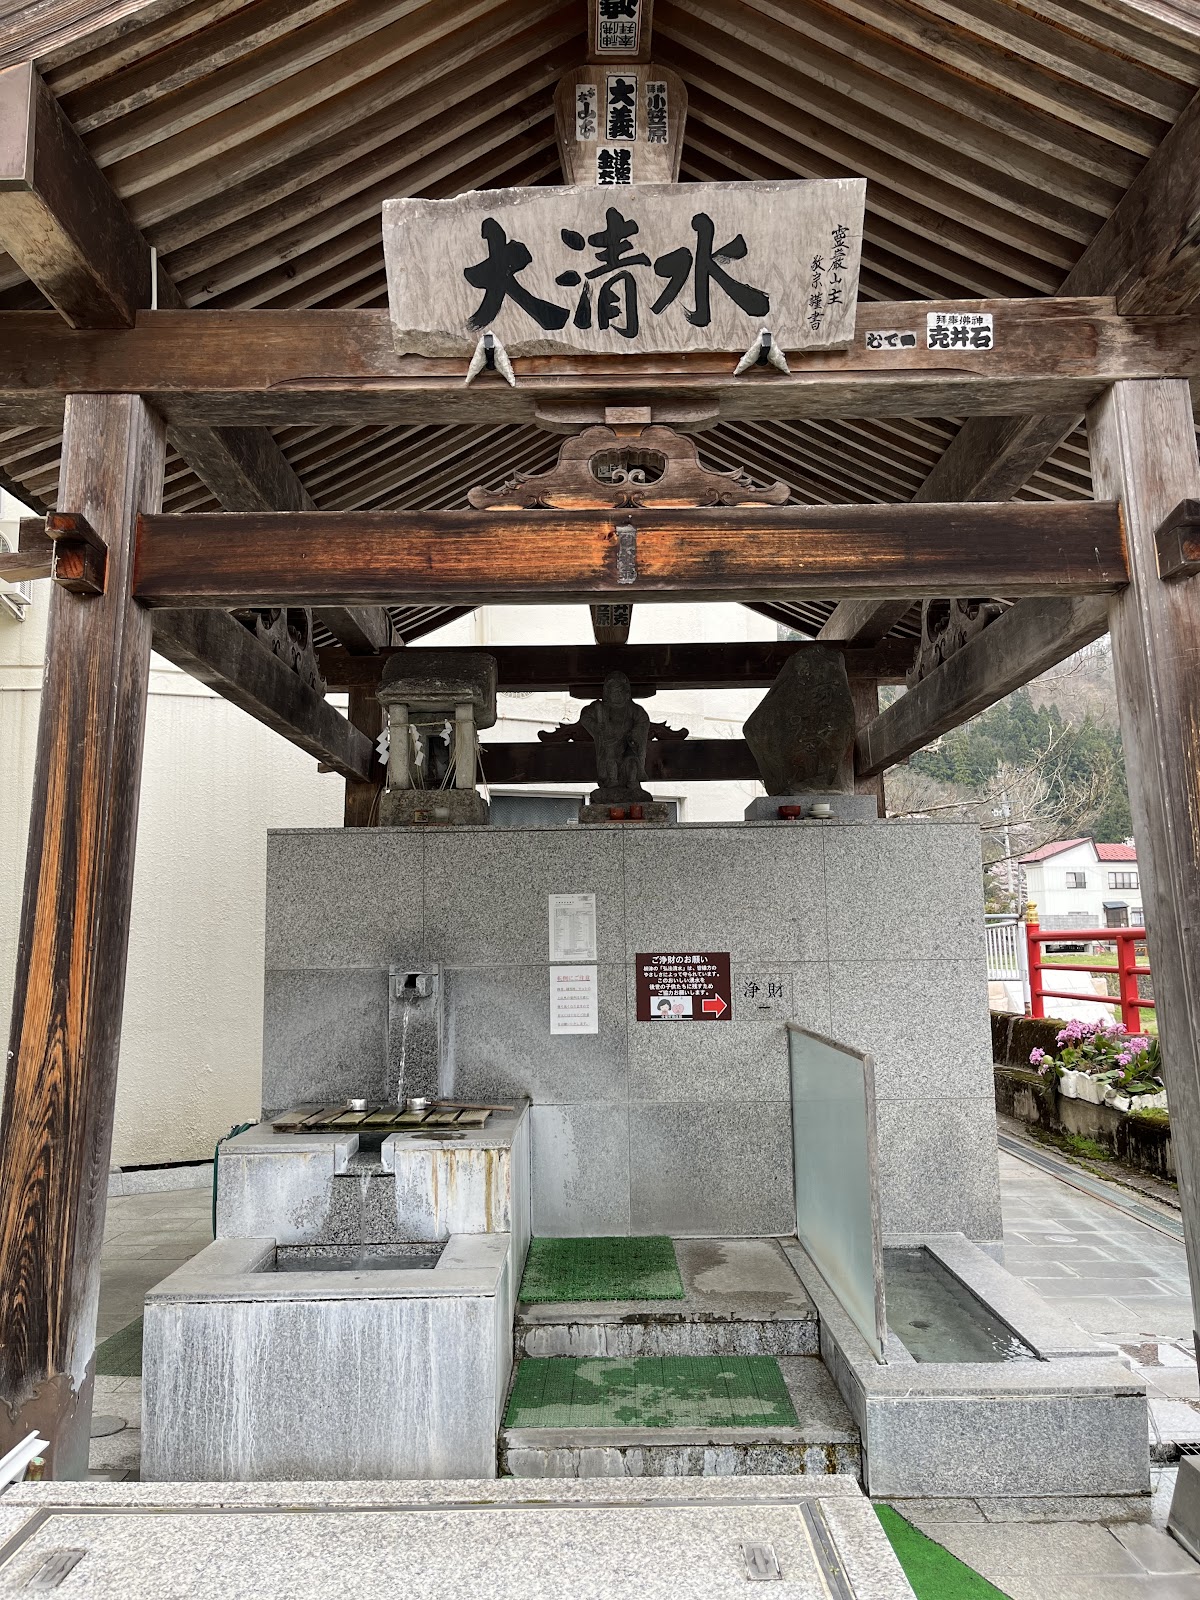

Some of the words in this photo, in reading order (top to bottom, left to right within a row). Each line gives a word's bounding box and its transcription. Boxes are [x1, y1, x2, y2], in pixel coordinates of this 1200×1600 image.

[647, 94, 667, 143] 小笠原
[464, 206, 770, 339] 大清水
[652, 955, 708, 965] ご浄財のお願い
